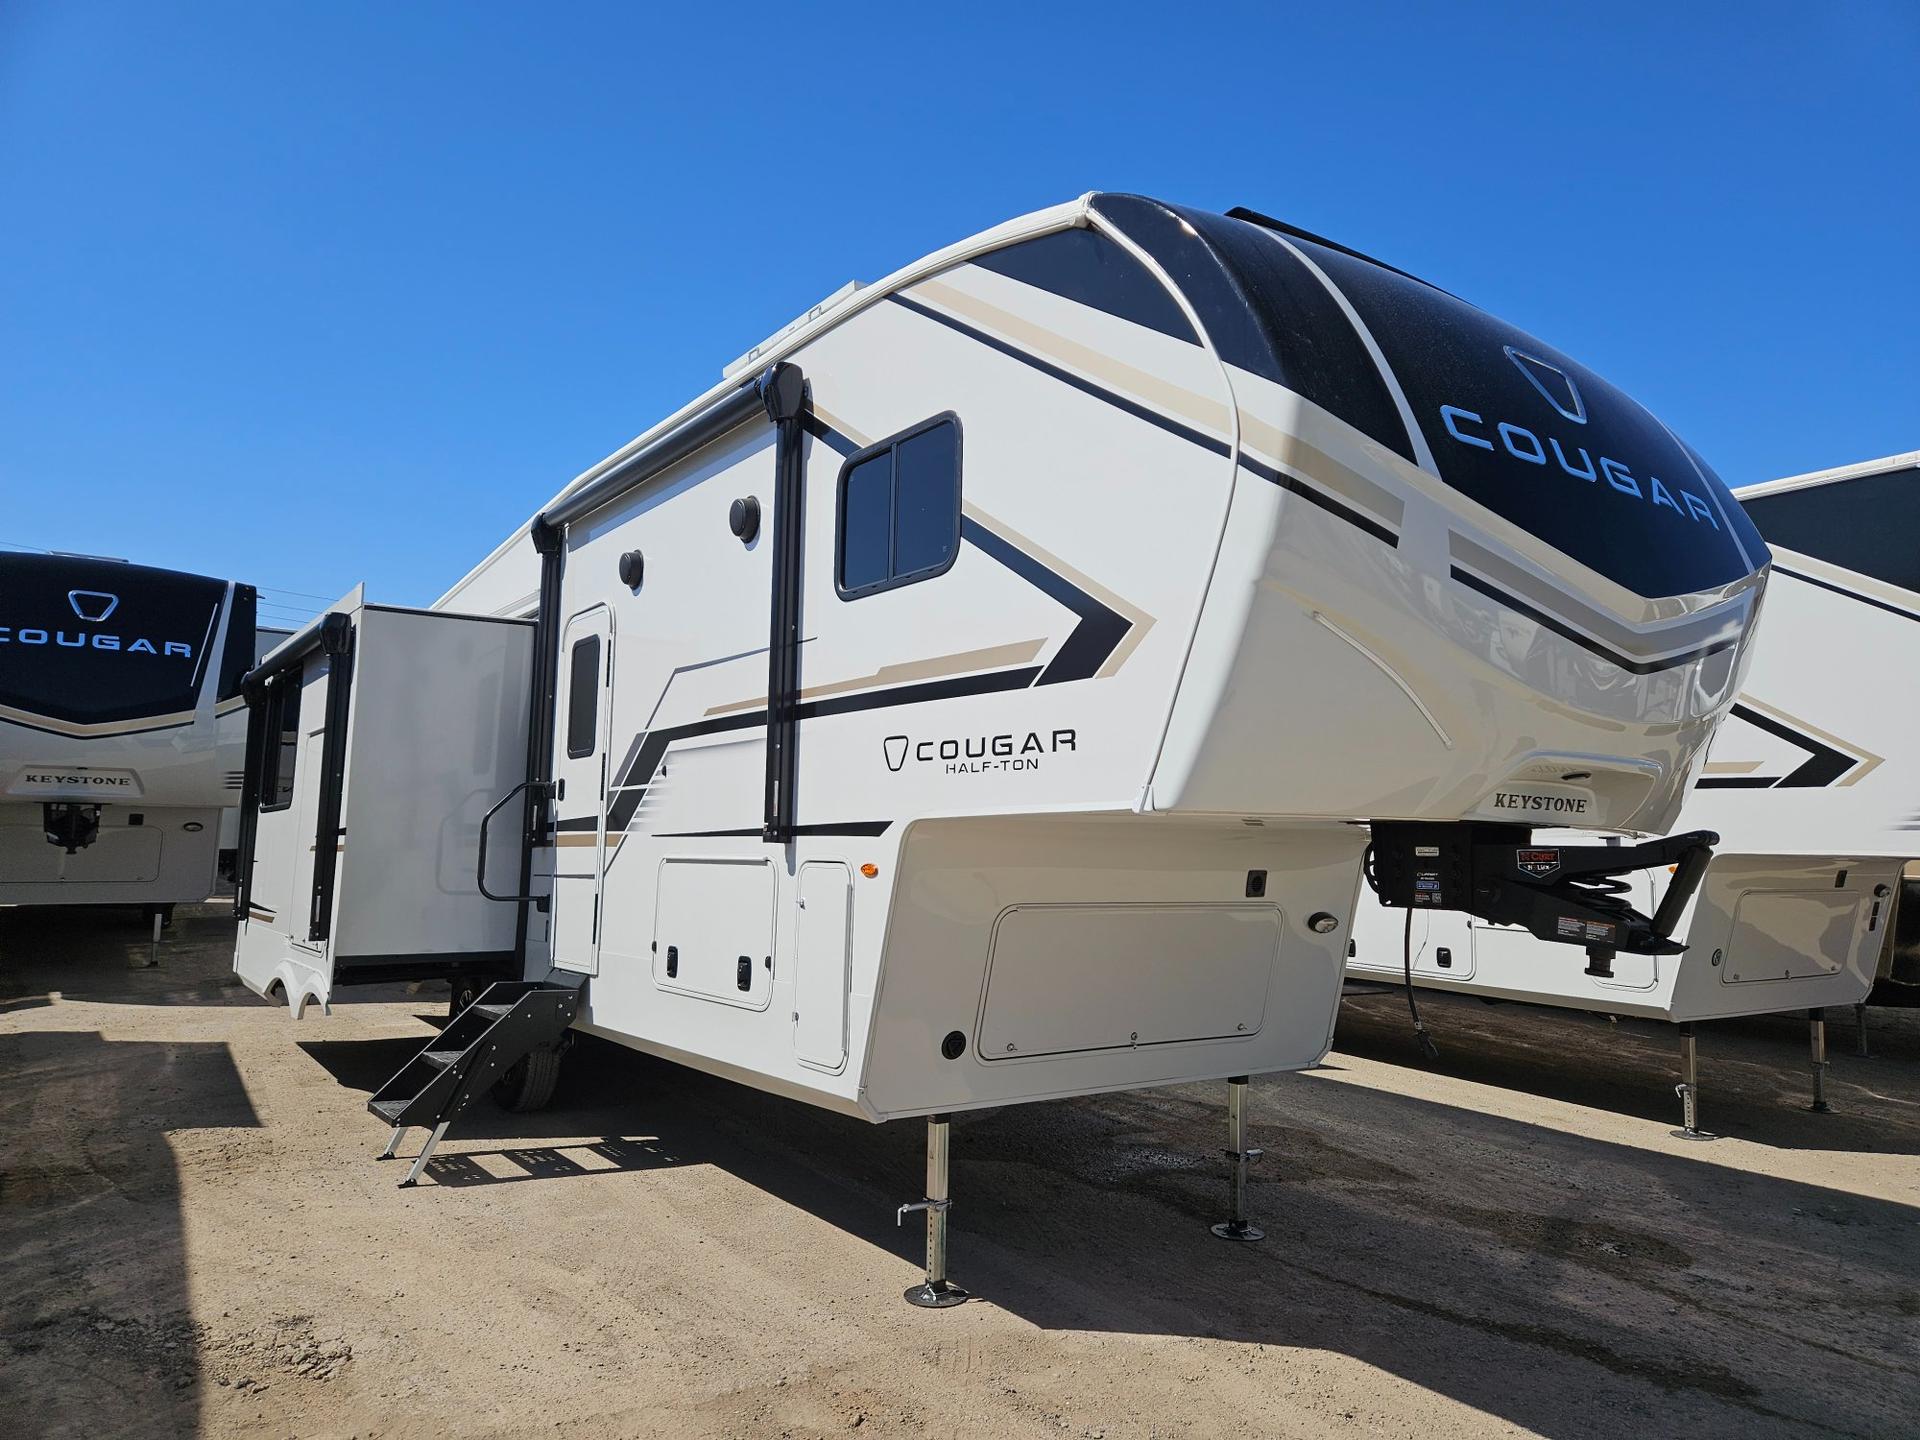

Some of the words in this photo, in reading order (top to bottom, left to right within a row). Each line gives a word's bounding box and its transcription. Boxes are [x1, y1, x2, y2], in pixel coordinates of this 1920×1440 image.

[1440, 404, 1720, 532] COUGAR
[916, 729, 1077, 762] COUGAR
[945, 758, 1040, 775] HALF-TON
[25, 775, 130, 786] KEYSTONE
[1494, 793, 1588, 813] KEYSTONE
